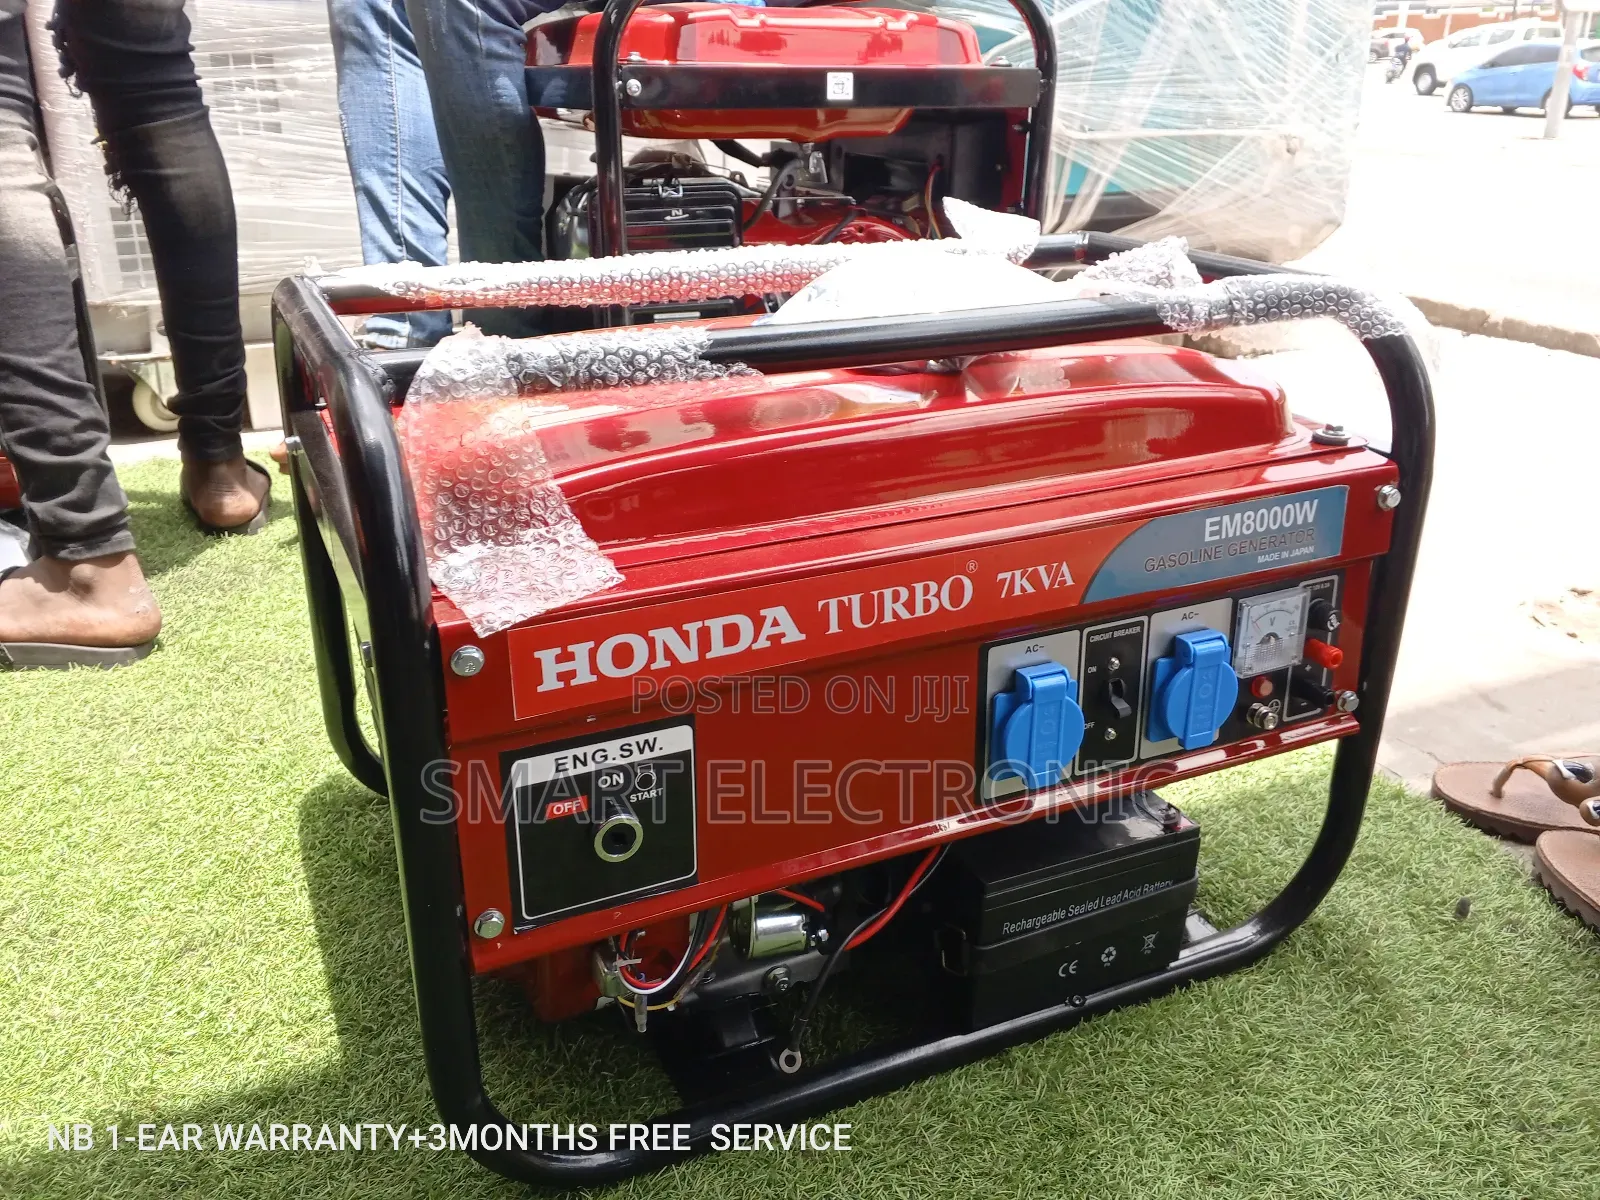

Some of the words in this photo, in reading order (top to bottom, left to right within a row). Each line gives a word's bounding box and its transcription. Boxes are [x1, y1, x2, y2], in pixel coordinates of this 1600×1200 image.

[1204, 499, 1319, 543] EM8000W
[1144, 546, 1223, 573] GASOLINE
[1227, 528, 1316, 557] GENERATOR
[1257, 552, 1280, 564] MADE
[1281, 550, 1290, 559] IN
[1290, 545, 1315, 557] JAPAN
[533, 605, 806, 693] HONDA
[996, 560, 1076, 599] 7KVA
[1089, 634, 1114, 643] CIRCUIT
[1113, 626, 1142, 639] BREAKER
[1087, 666, 1098, 674] ON
[554, 736, 665, 774] ENG.SW.
[597, 772, 626, 789] ON
[629, 787, 665, 804] START
[552, 800, 583, 816] OFF
[1002, 909, 1067, 935] Rechargeable
[1067, 896, 1100, 916] Sealed
[1100, 890, 1123, 908] Lead
[1122, 886, 1142, 902] Acid
[1142, 879, 1174, 896] Battery
